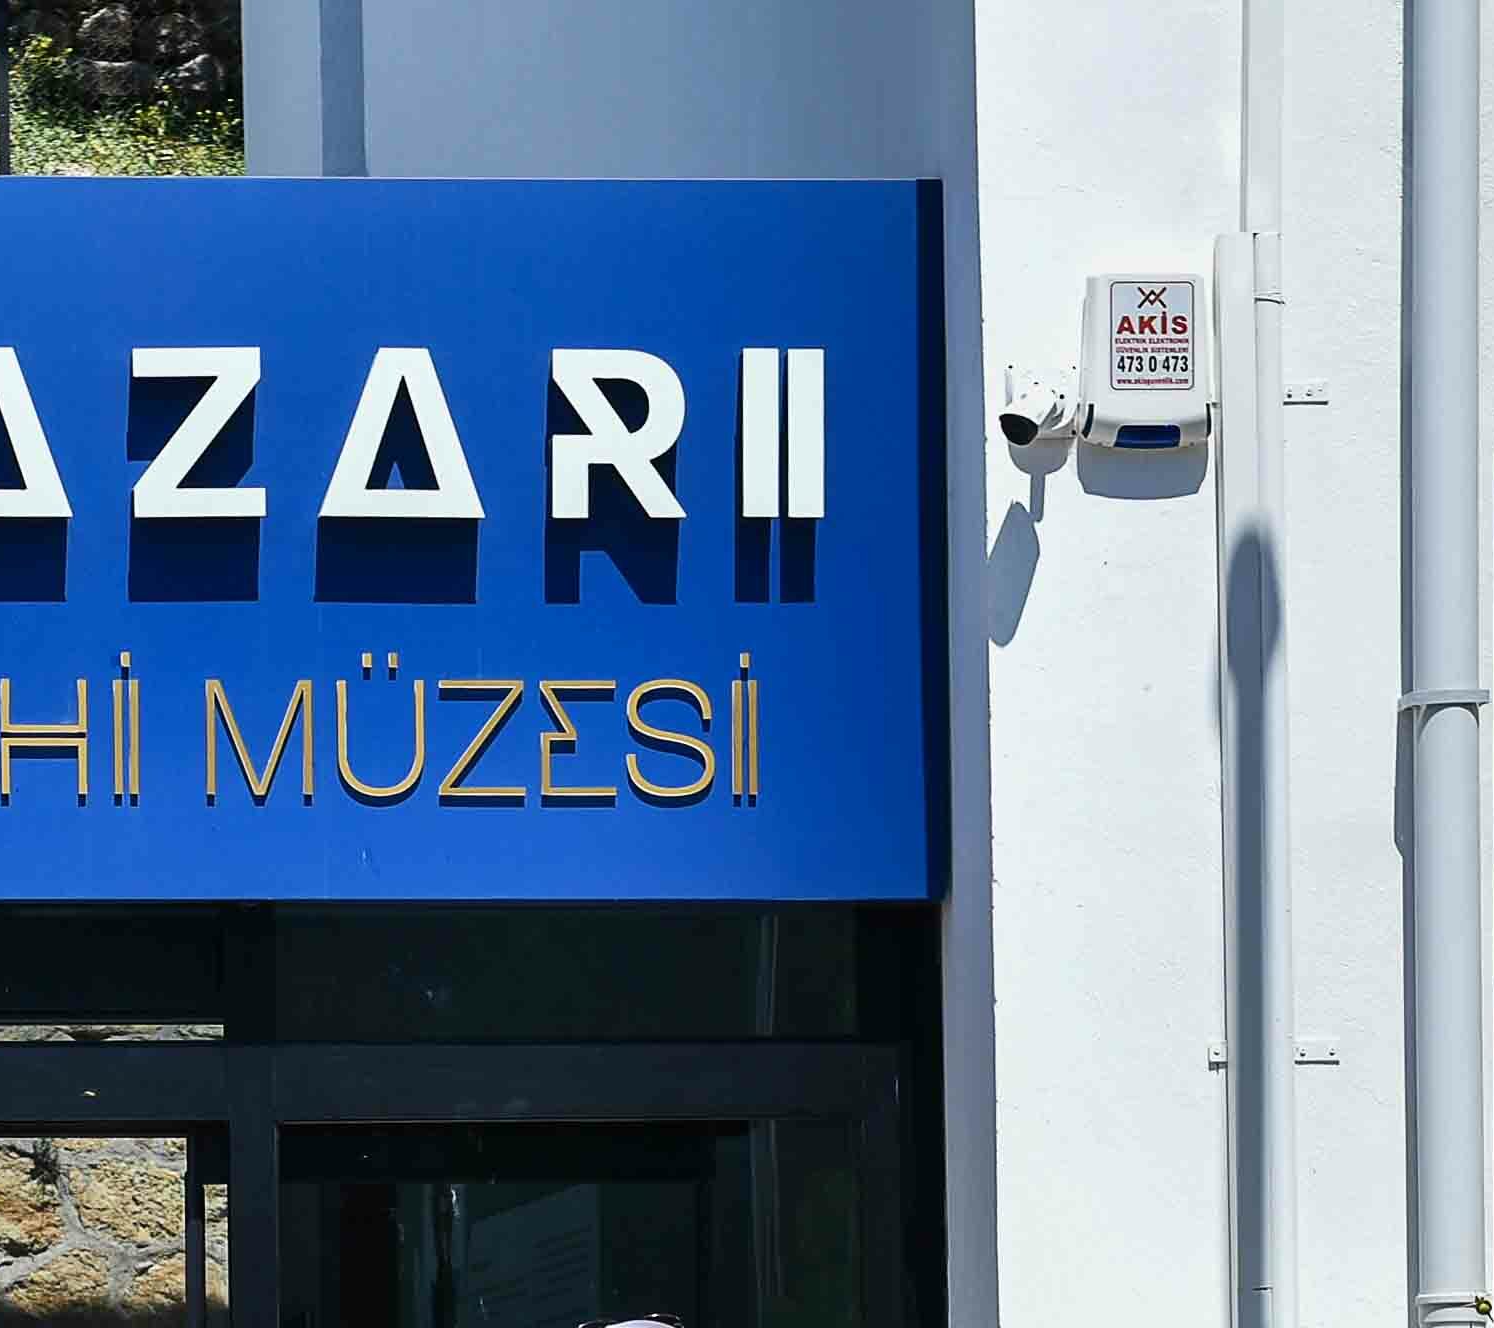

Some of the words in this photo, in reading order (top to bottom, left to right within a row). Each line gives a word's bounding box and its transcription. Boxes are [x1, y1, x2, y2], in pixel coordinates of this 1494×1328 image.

[1116, 310, 1189, 335] AKİS
[1117, 355, 1144, 373] 473
[1148, 355, 1158, 373] 0
[1162, 355, 1189, 373] 473
[207, 654, 758, 797] MÜZESİ
